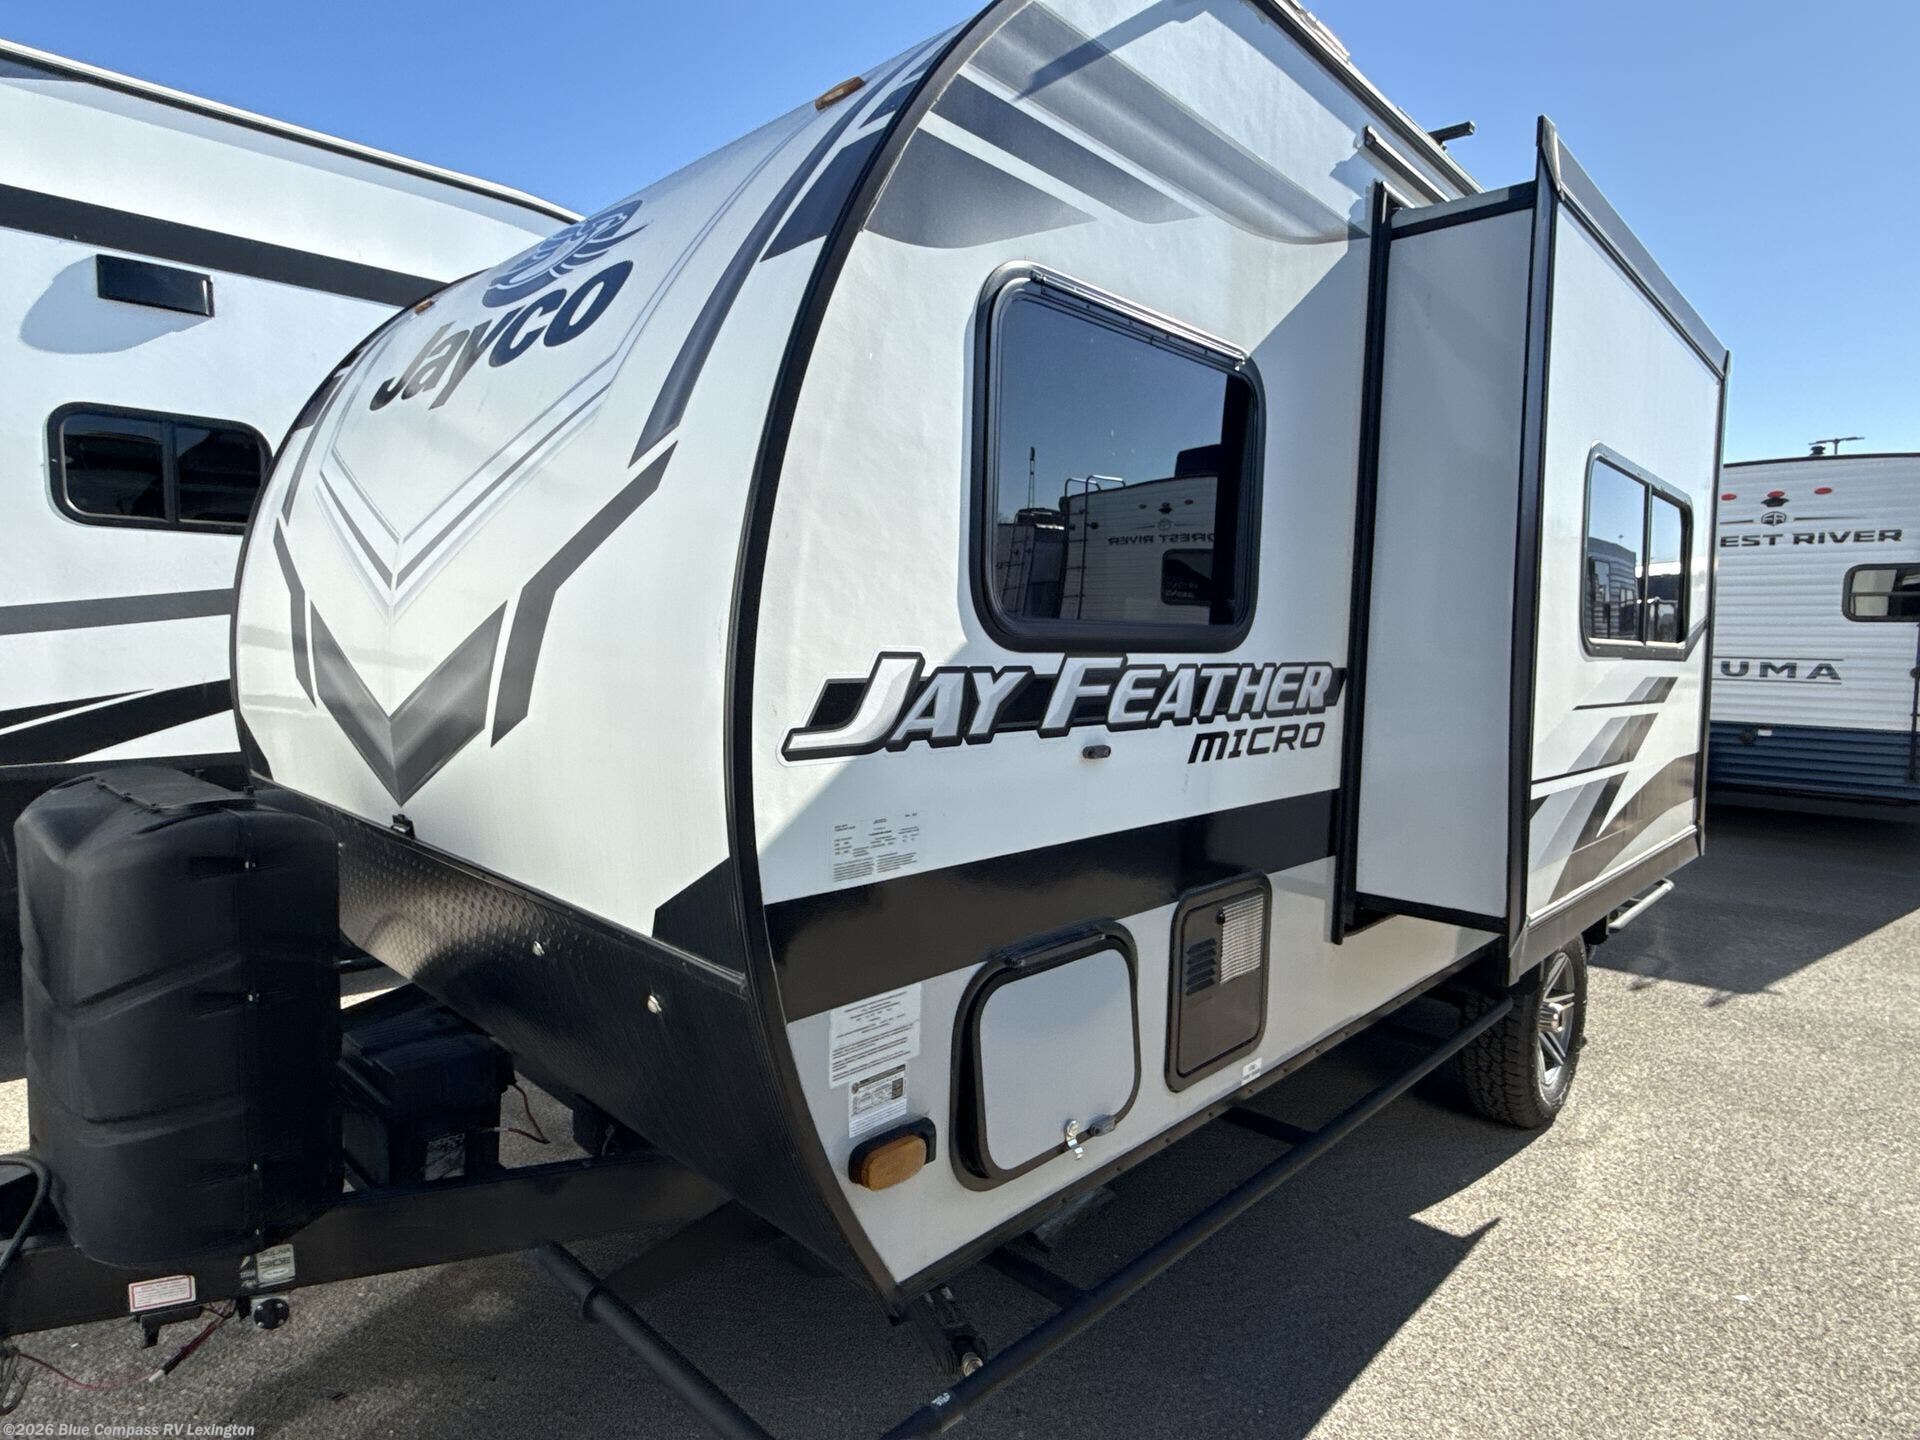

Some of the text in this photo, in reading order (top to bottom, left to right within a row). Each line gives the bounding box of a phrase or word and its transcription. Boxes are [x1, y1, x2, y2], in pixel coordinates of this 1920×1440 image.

[369, 260, 634, 411] Jayco
[1793, 529, 1902, 545] RIVER
[782, 651, 1333, 761] JAY FEATHER
[1187, 721, 1325, 764] MICRO
